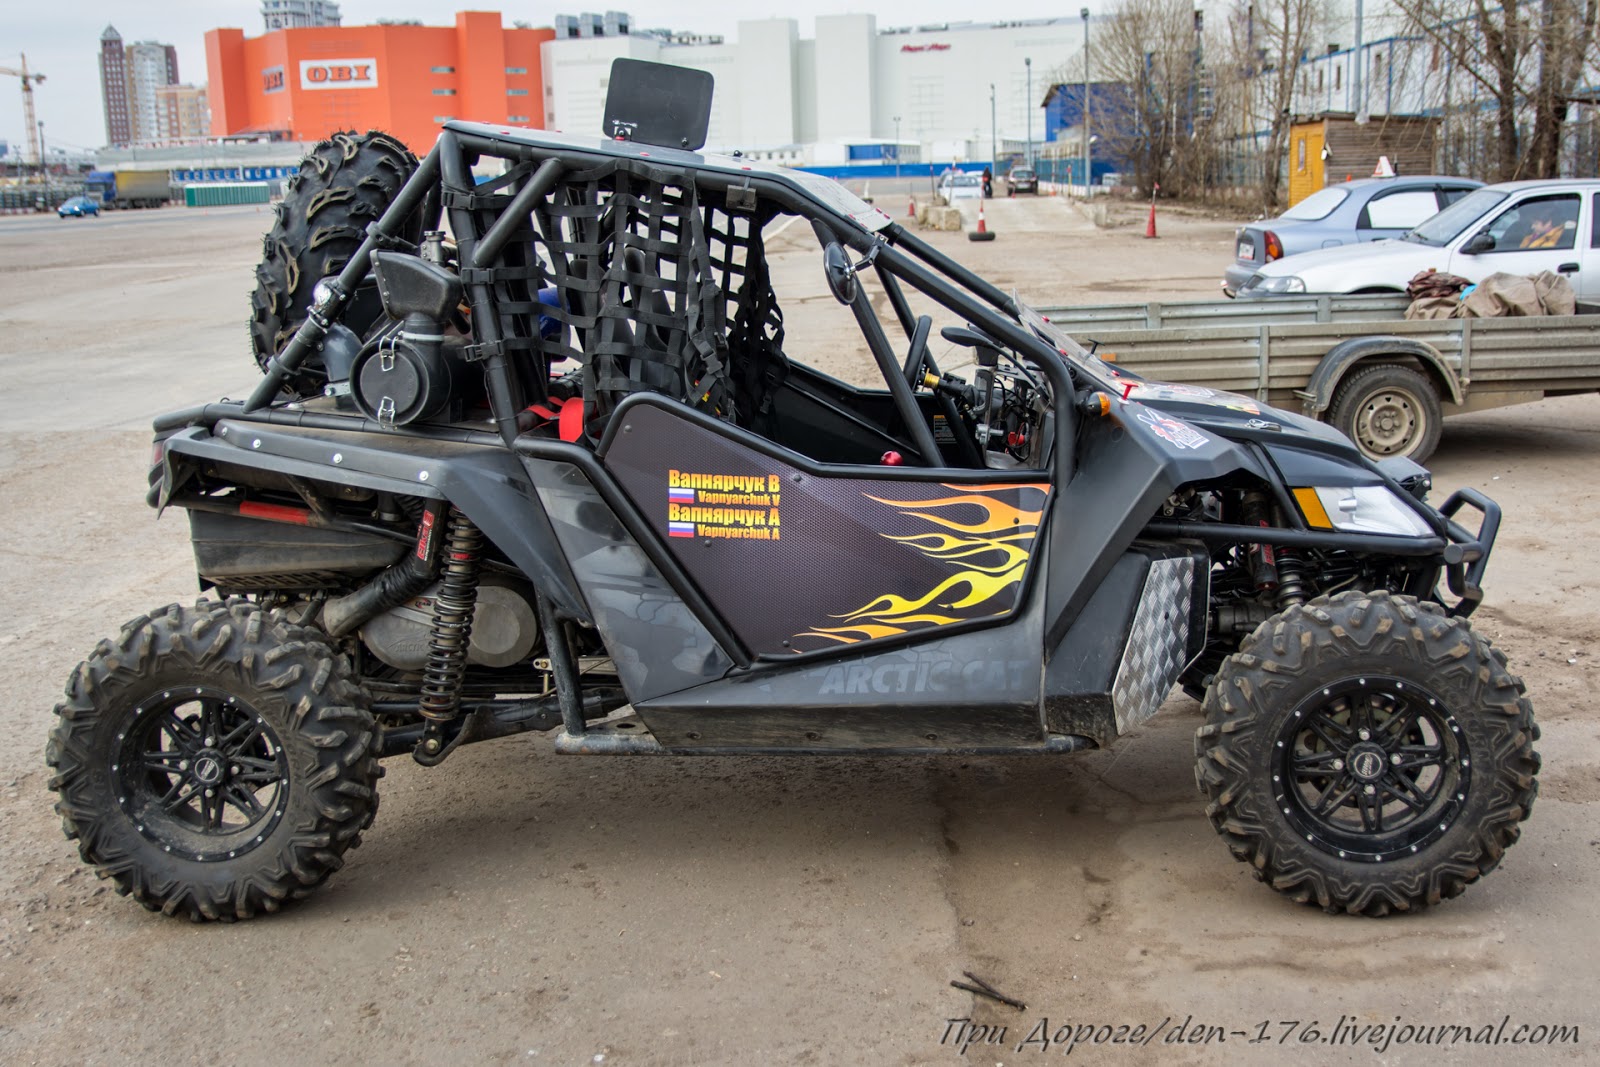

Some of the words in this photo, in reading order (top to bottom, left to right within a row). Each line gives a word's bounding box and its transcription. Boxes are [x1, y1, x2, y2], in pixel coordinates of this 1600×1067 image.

[306, 65, 370, 83] OBI
[668, 469, 765, 493] Вапнярчук
[768, 474, 780, 493] В
[698, 490, 771, 506] Vapnyarchuk
[772, 494, 781, 507] V
[668, 503, 766, 527] Вапнярчук
[697, 524, 771, 540] Vapnyarchuk
[772, 527, 781, 541] A
[818, 661, 953, 695] ARCTIC
[961, 660, 1033, 691] CAT
